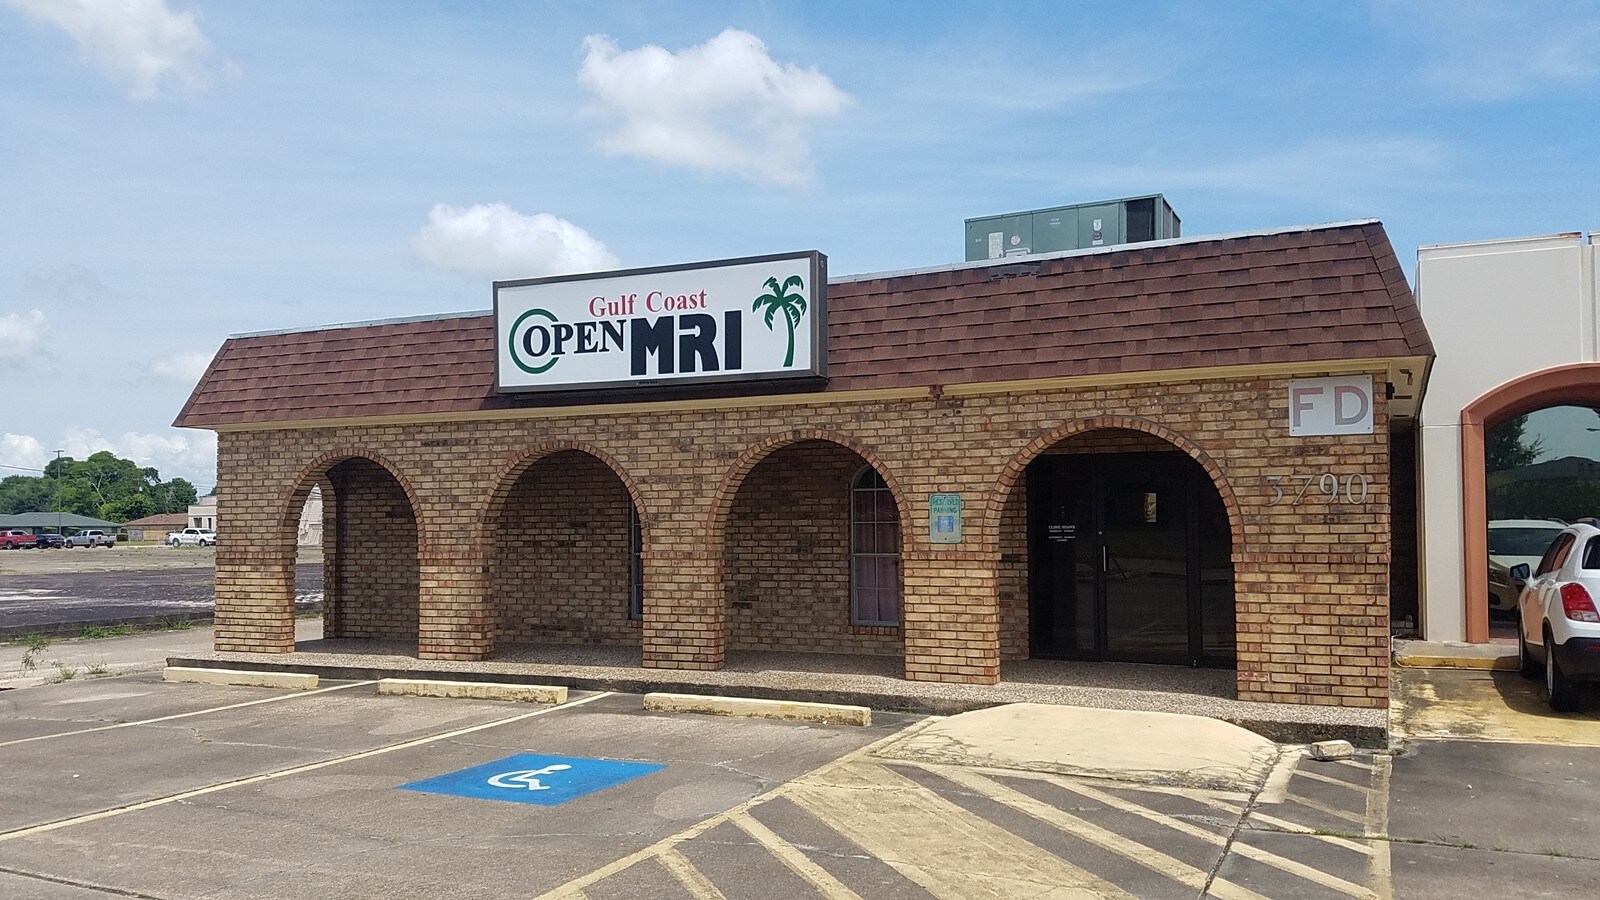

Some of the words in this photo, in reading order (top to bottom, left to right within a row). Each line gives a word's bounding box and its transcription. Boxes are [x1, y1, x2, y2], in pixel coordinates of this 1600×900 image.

[589, 294, 637, 317] Gulf
[646, 289, 708, 312] Coast
[522, 319, 628, 357] OPEN
[630, 310, 742, 376] MRI
[1266, 473, 1368, 507] 3790
